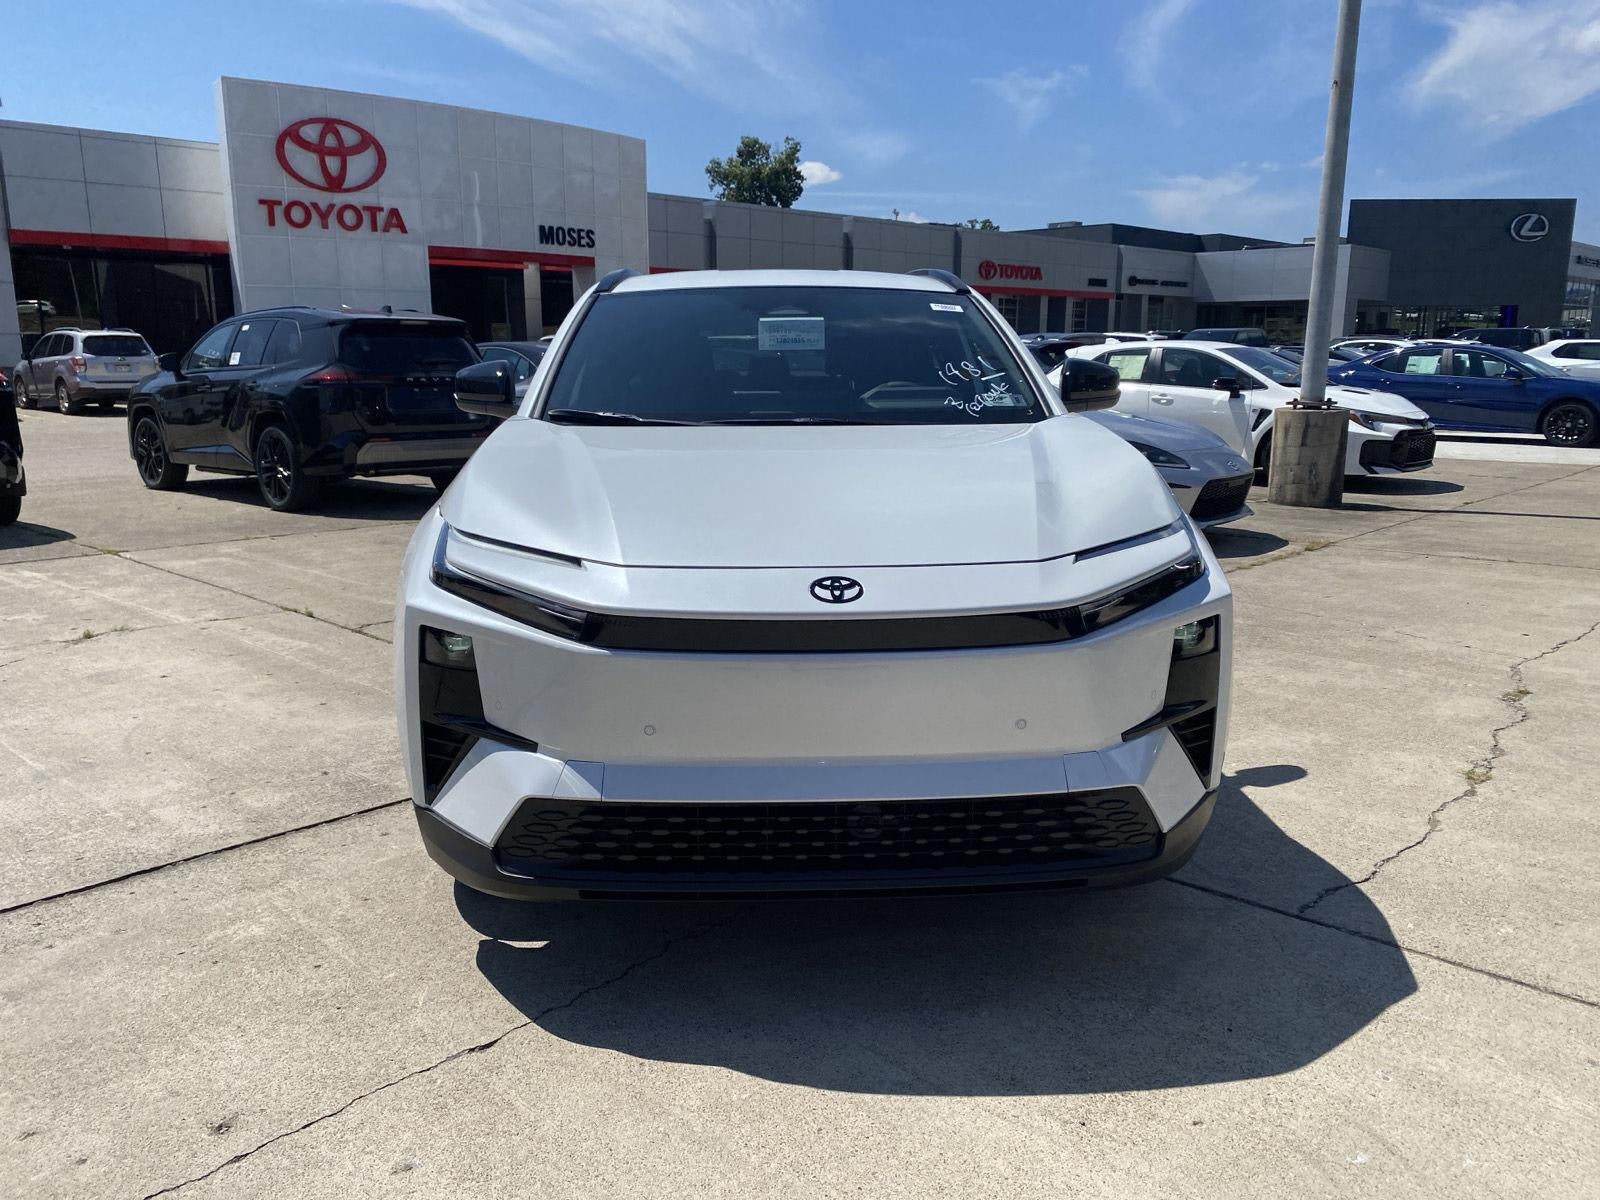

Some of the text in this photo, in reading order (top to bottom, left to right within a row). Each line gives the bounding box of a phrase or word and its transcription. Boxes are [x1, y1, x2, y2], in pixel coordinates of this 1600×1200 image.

[258, 198, 408, 234] TOYOTA
[538, 224, 596, 248] MOSES
[998, 263, 1043, 280] TOYOTA
